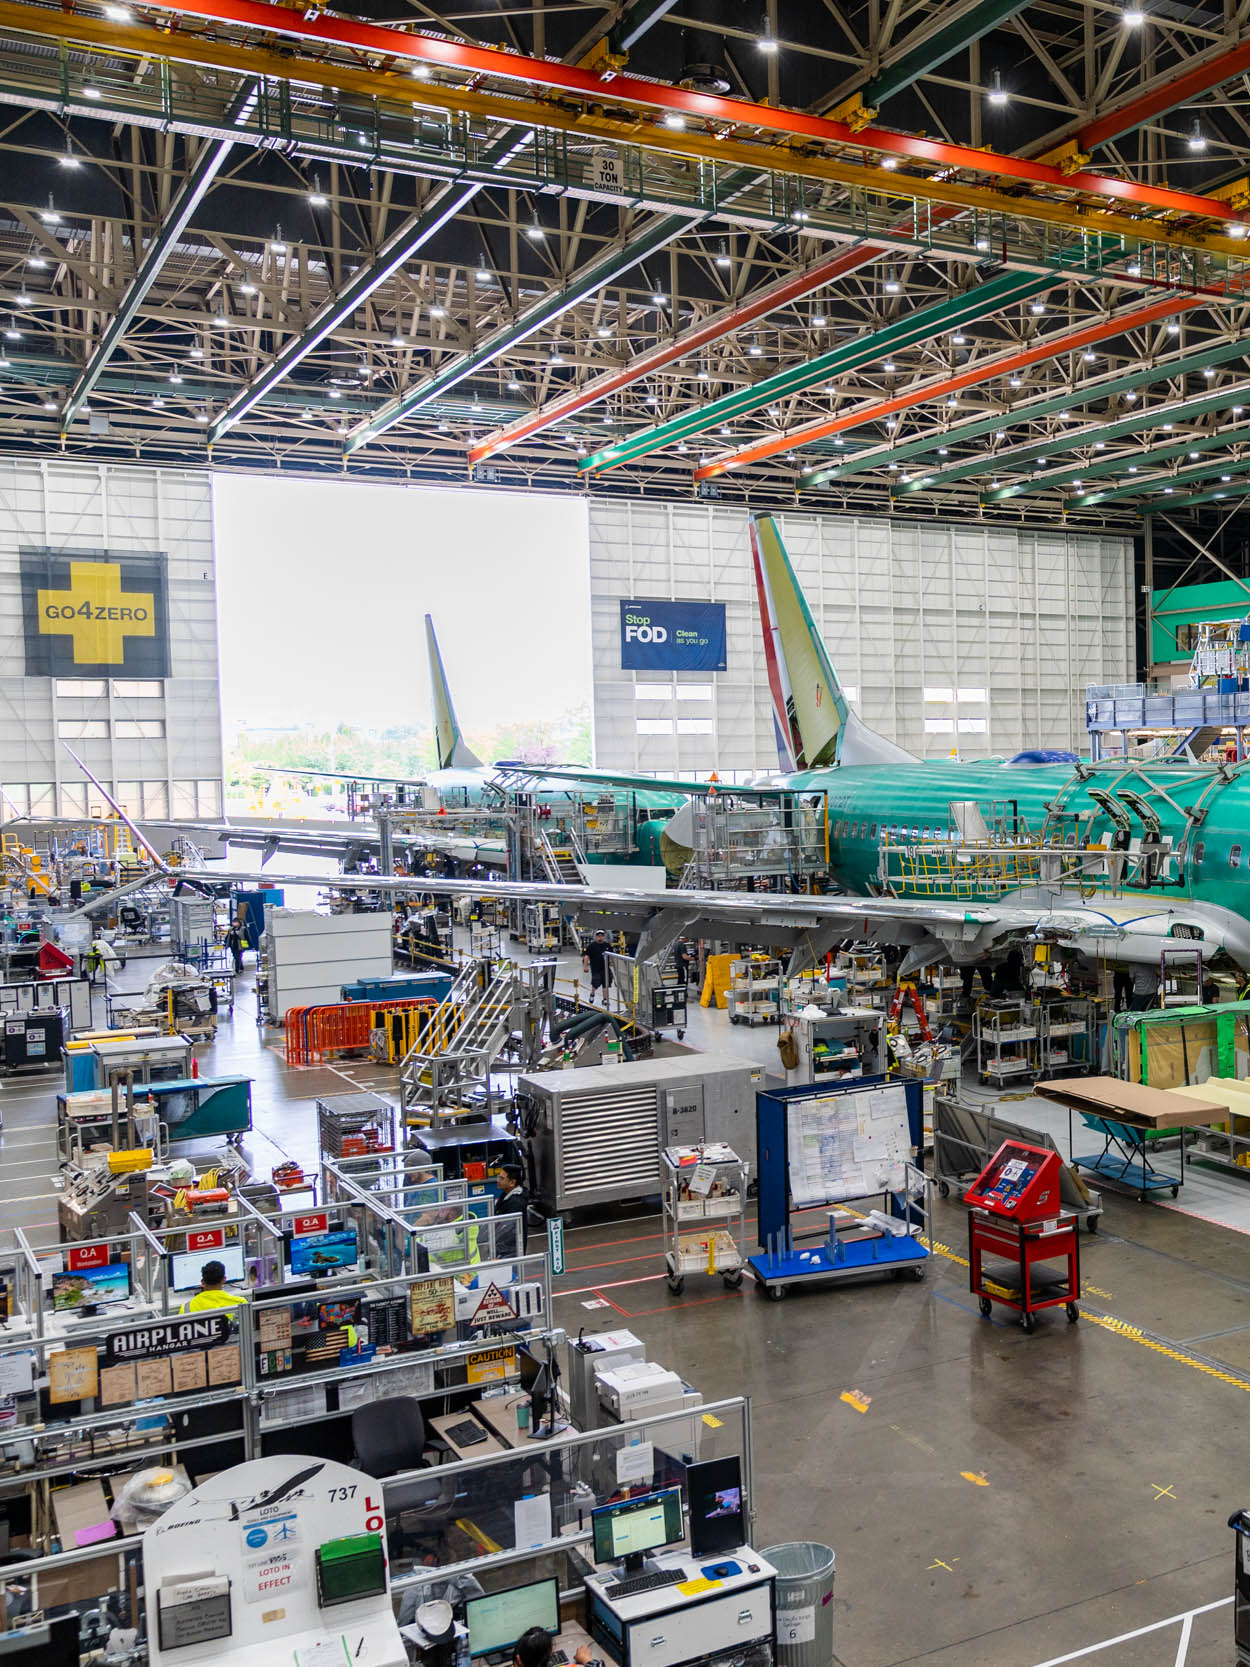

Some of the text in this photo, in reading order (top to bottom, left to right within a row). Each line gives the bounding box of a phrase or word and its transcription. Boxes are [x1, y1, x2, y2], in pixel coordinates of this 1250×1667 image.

[602, 160, 614, 171] 30
[600, 172, 618, 184] TON
[594, 182, 623, 192] CAPACITY
[45, 600, 148, 621] GO4ZERO
[625, 614, 650, 626] Stop
[625, 626, 667, 643] FOD
[489, 1312, 511, 1320] BEWARE
[113, 1318, 222, 1352] AIRPLANE
[149, 1341, 188, 1352] HANGAR
[470, 1347, 513, 1364] CAUTION
[328, 1485, 357, 1503] 737
[260, 1506, 279, 1516] LOTO
[168, 1519, 200, 1529] BOEING
[259, 1566, 280, 1577] LOTO
[258, 1576, 291, 1591] EFFECT
[790, 1629, 796, 1638] 6
